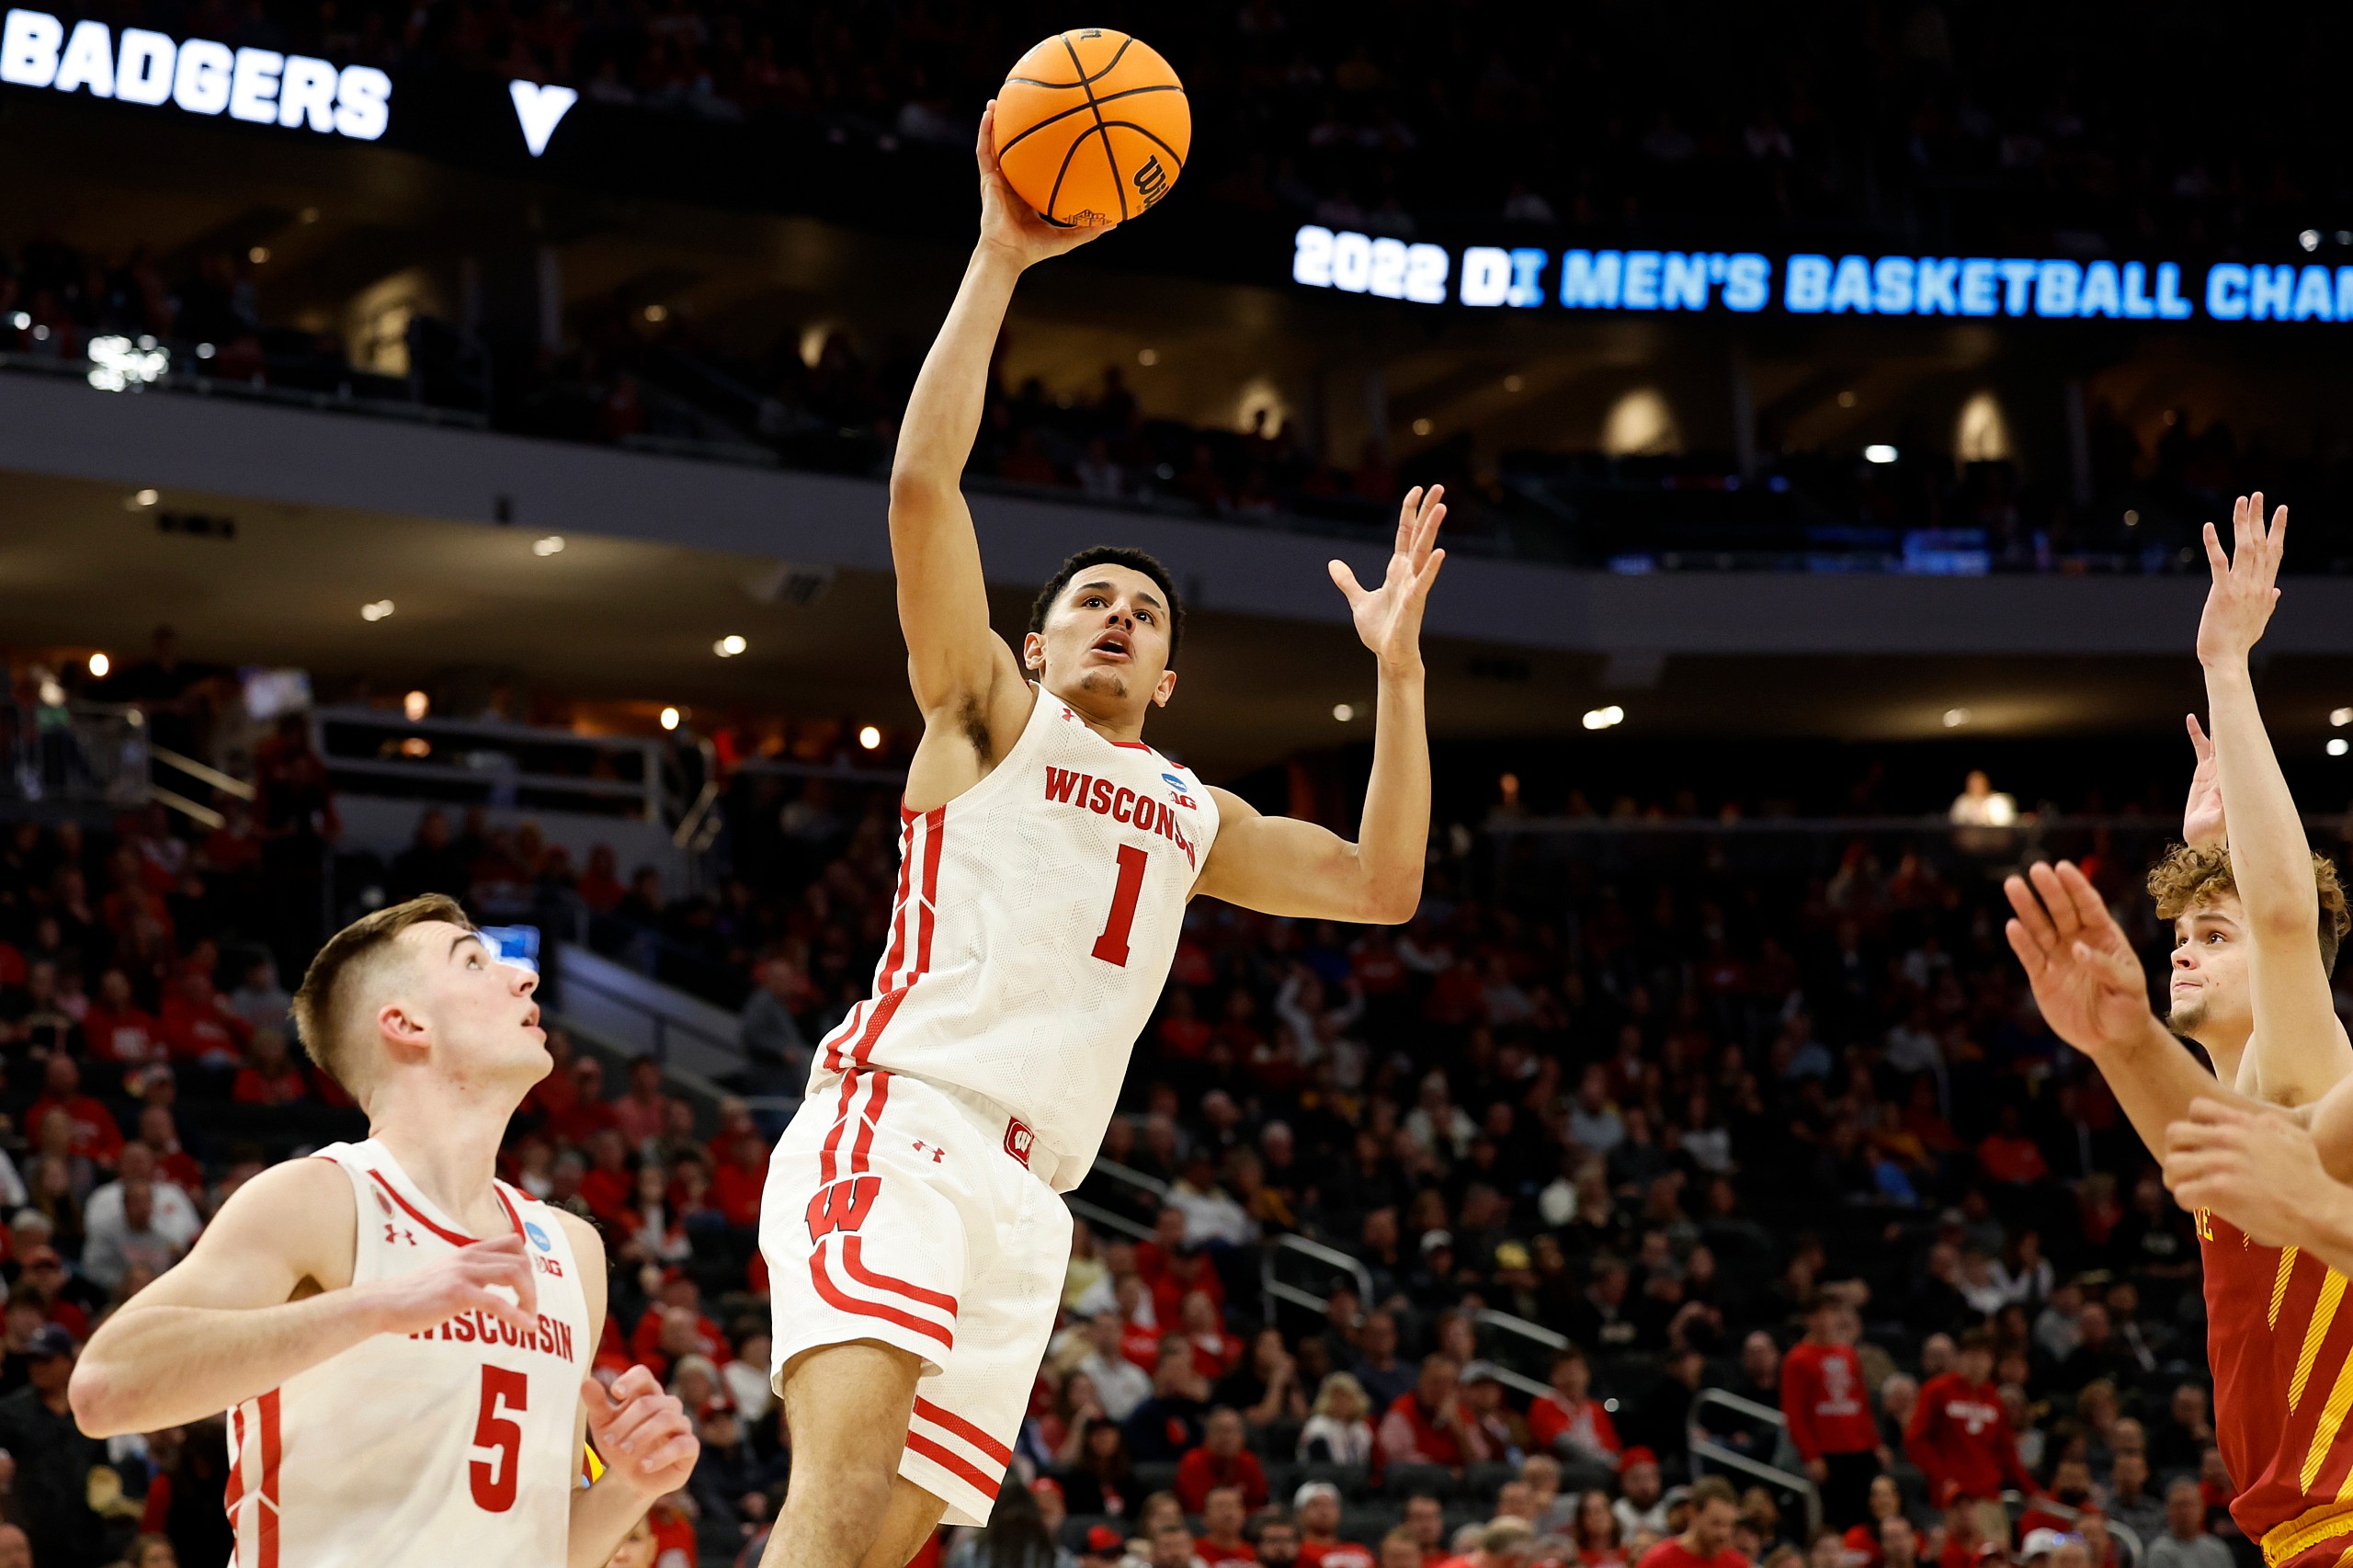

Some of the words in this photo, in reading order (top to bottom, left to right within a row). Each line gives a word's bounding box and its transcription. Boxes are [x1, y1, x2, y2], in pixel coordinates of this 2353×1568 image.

[0, 7, 393, 141] BADGERS
[1292, 224, 1450, 304] 2022
[1559, 248, 1772, 312] MEN'S
[1783, 253, 2194, 320] BASKETBALL
[1045, 766, 1196, 872] WISCONSN
[1091, 843, 1148, 968] 1
[804, 1176, 882, 1246] W
[409, 1308, 574, 1363] ISCONSIN
[469, 1363, 528, 1513] 5
